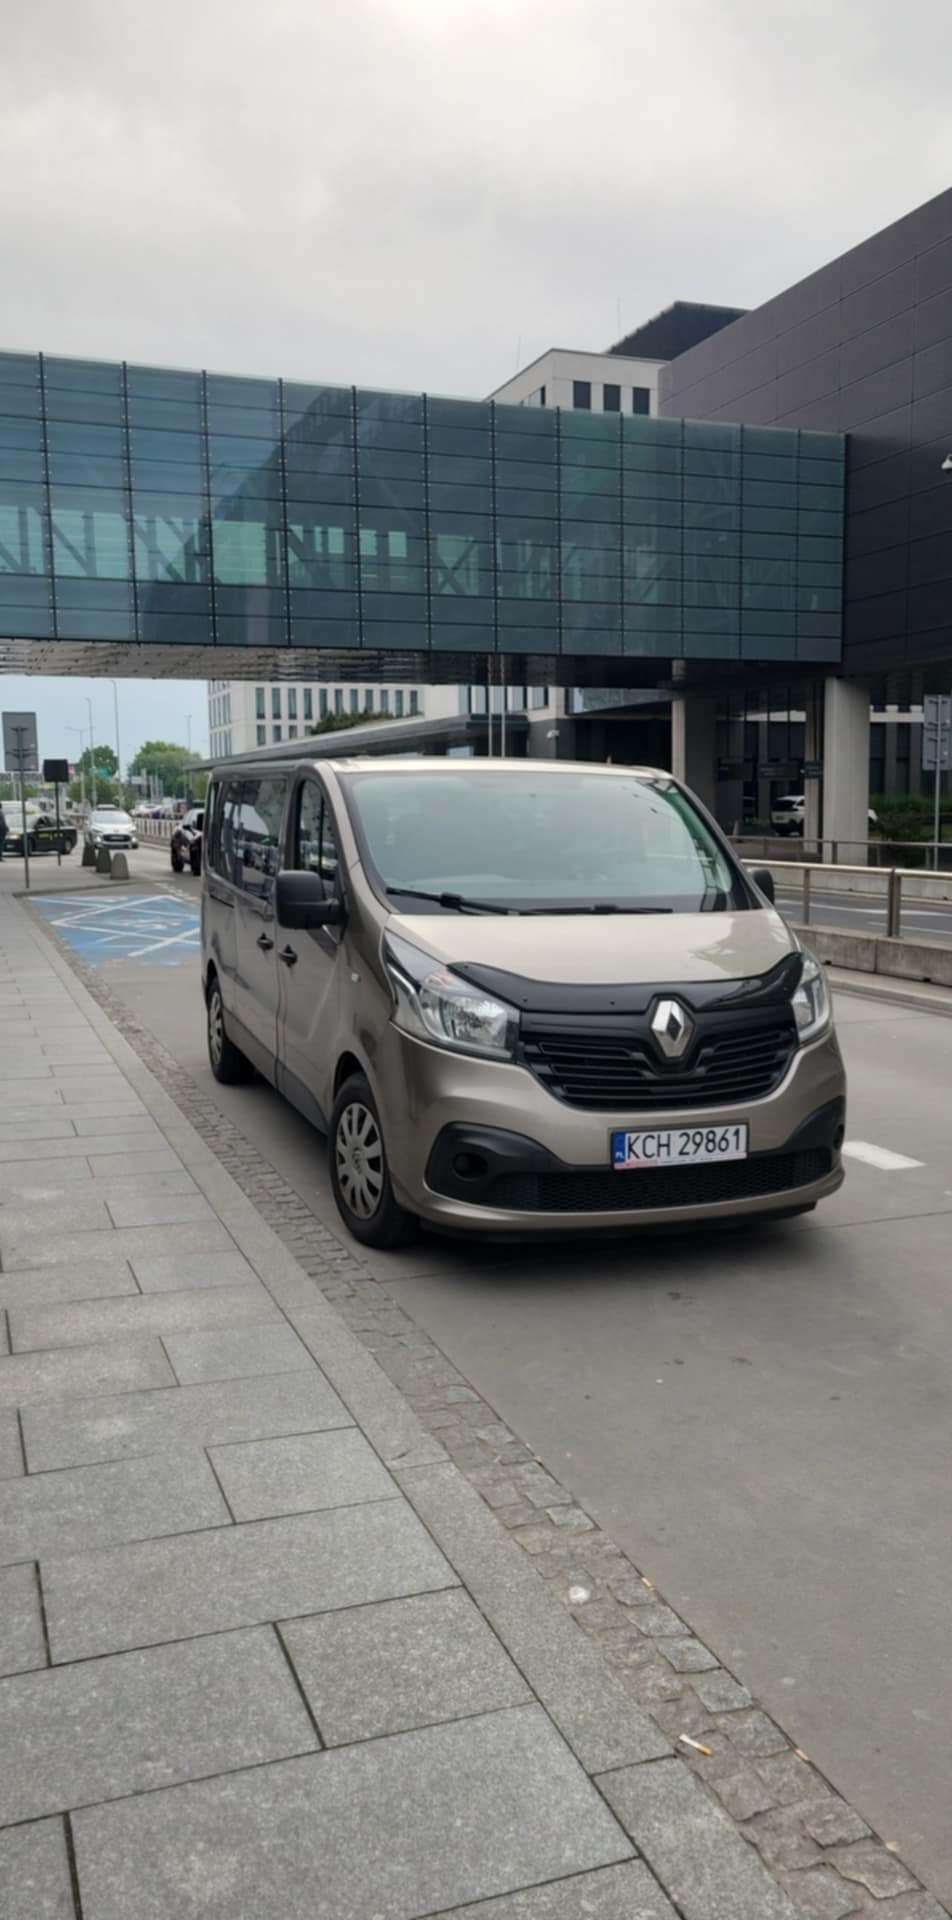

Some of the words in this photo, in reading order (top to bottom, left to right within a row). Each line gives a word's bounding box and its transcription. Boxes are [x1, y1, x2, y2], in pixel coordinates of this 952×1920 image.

[627, 1133, 671, 1159] KCH
[679, 1128, 740, 1156] 29861
[615, 1151, 625, 1159] PL
